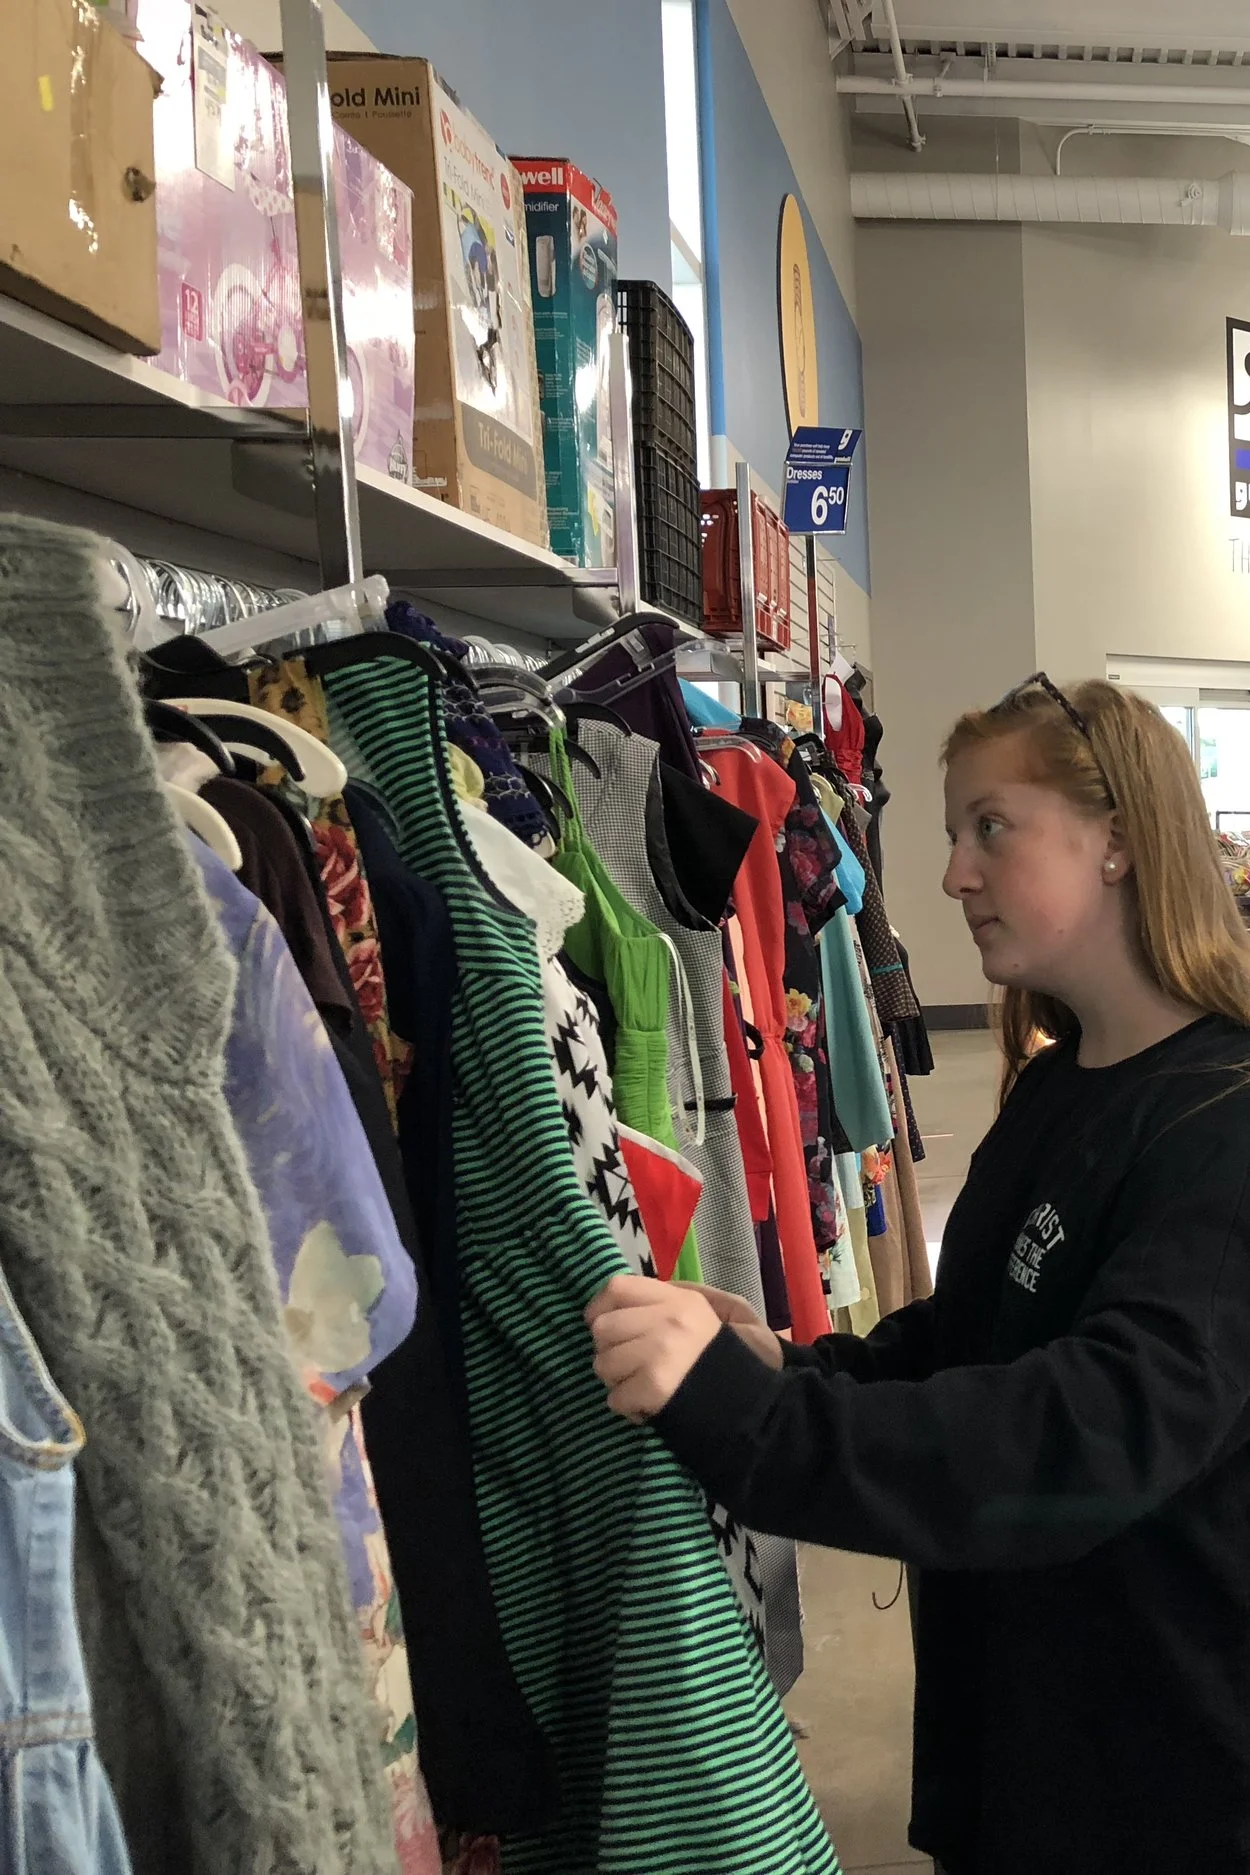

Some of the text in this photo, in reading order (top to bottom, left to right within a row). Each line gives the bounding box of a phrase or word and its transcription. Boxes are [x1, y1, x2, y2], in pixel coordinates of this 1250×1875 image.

[331, 86, 420, 107] old Mini
[521, 167, 564, 186] well
[786, 466, 823, 480] Dresses
